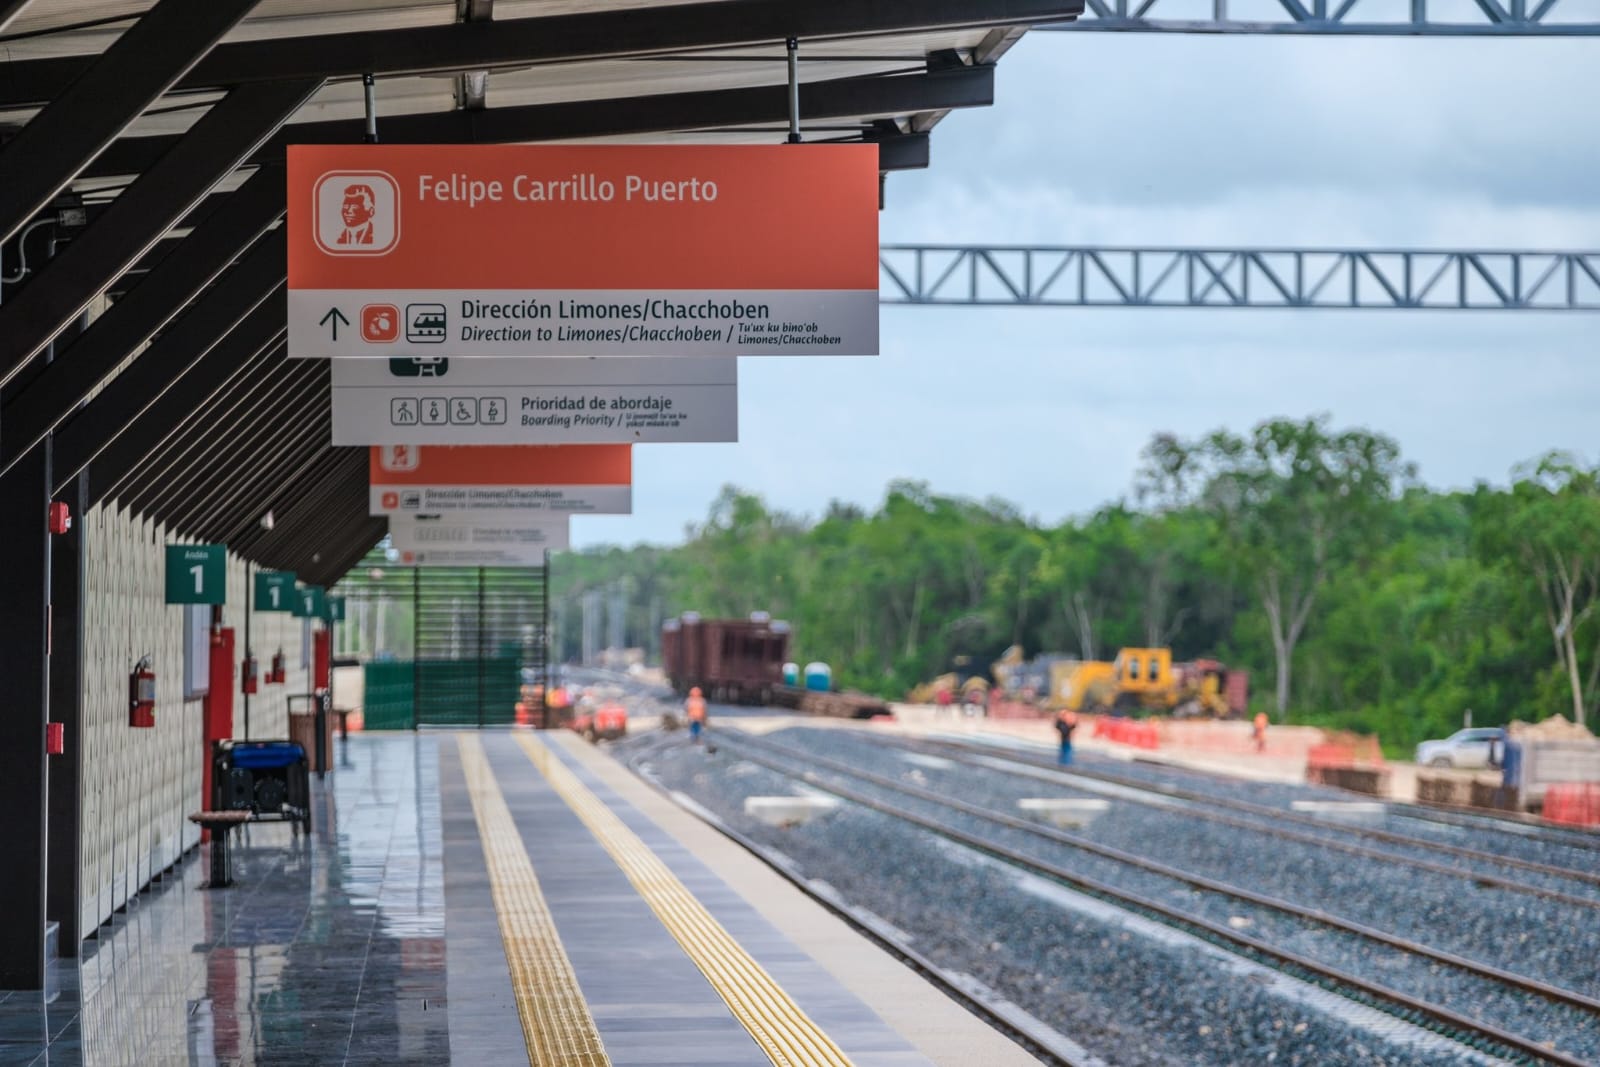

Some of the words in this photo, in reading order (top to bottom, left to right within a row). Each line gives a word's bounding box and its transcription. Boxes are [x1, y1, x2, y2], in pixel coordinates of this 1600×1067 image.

[418, 173, 503, 208] Felipe
[512, 174, 615, 201] Carrillo
[625, 175, 718, 201] Puerto
[461, 299, 551, 319] Dirección
[559, 299, 769, 322] Limones/Chacchoben
[461, 325, 532, 341] Direction
[537, 327, 552, 341] to
[558, 325, 721, 343] Limones/Chacchoben
[767, 322, 780, 333] ku
[738, 334, 841, 345] Limones/Chacchoben
[521, 396, 586, 410] Prioridad
[589, 396, 606, 410] de
[610, 396, 672, 412] abordaje
[521, 414, 571, 428] Boarding
[574, 414, 615, 428] Priority
[189, 565, 204, 595] 1
[269, 586, 281, 609] 1
[304, 596, 314, 615] 1
